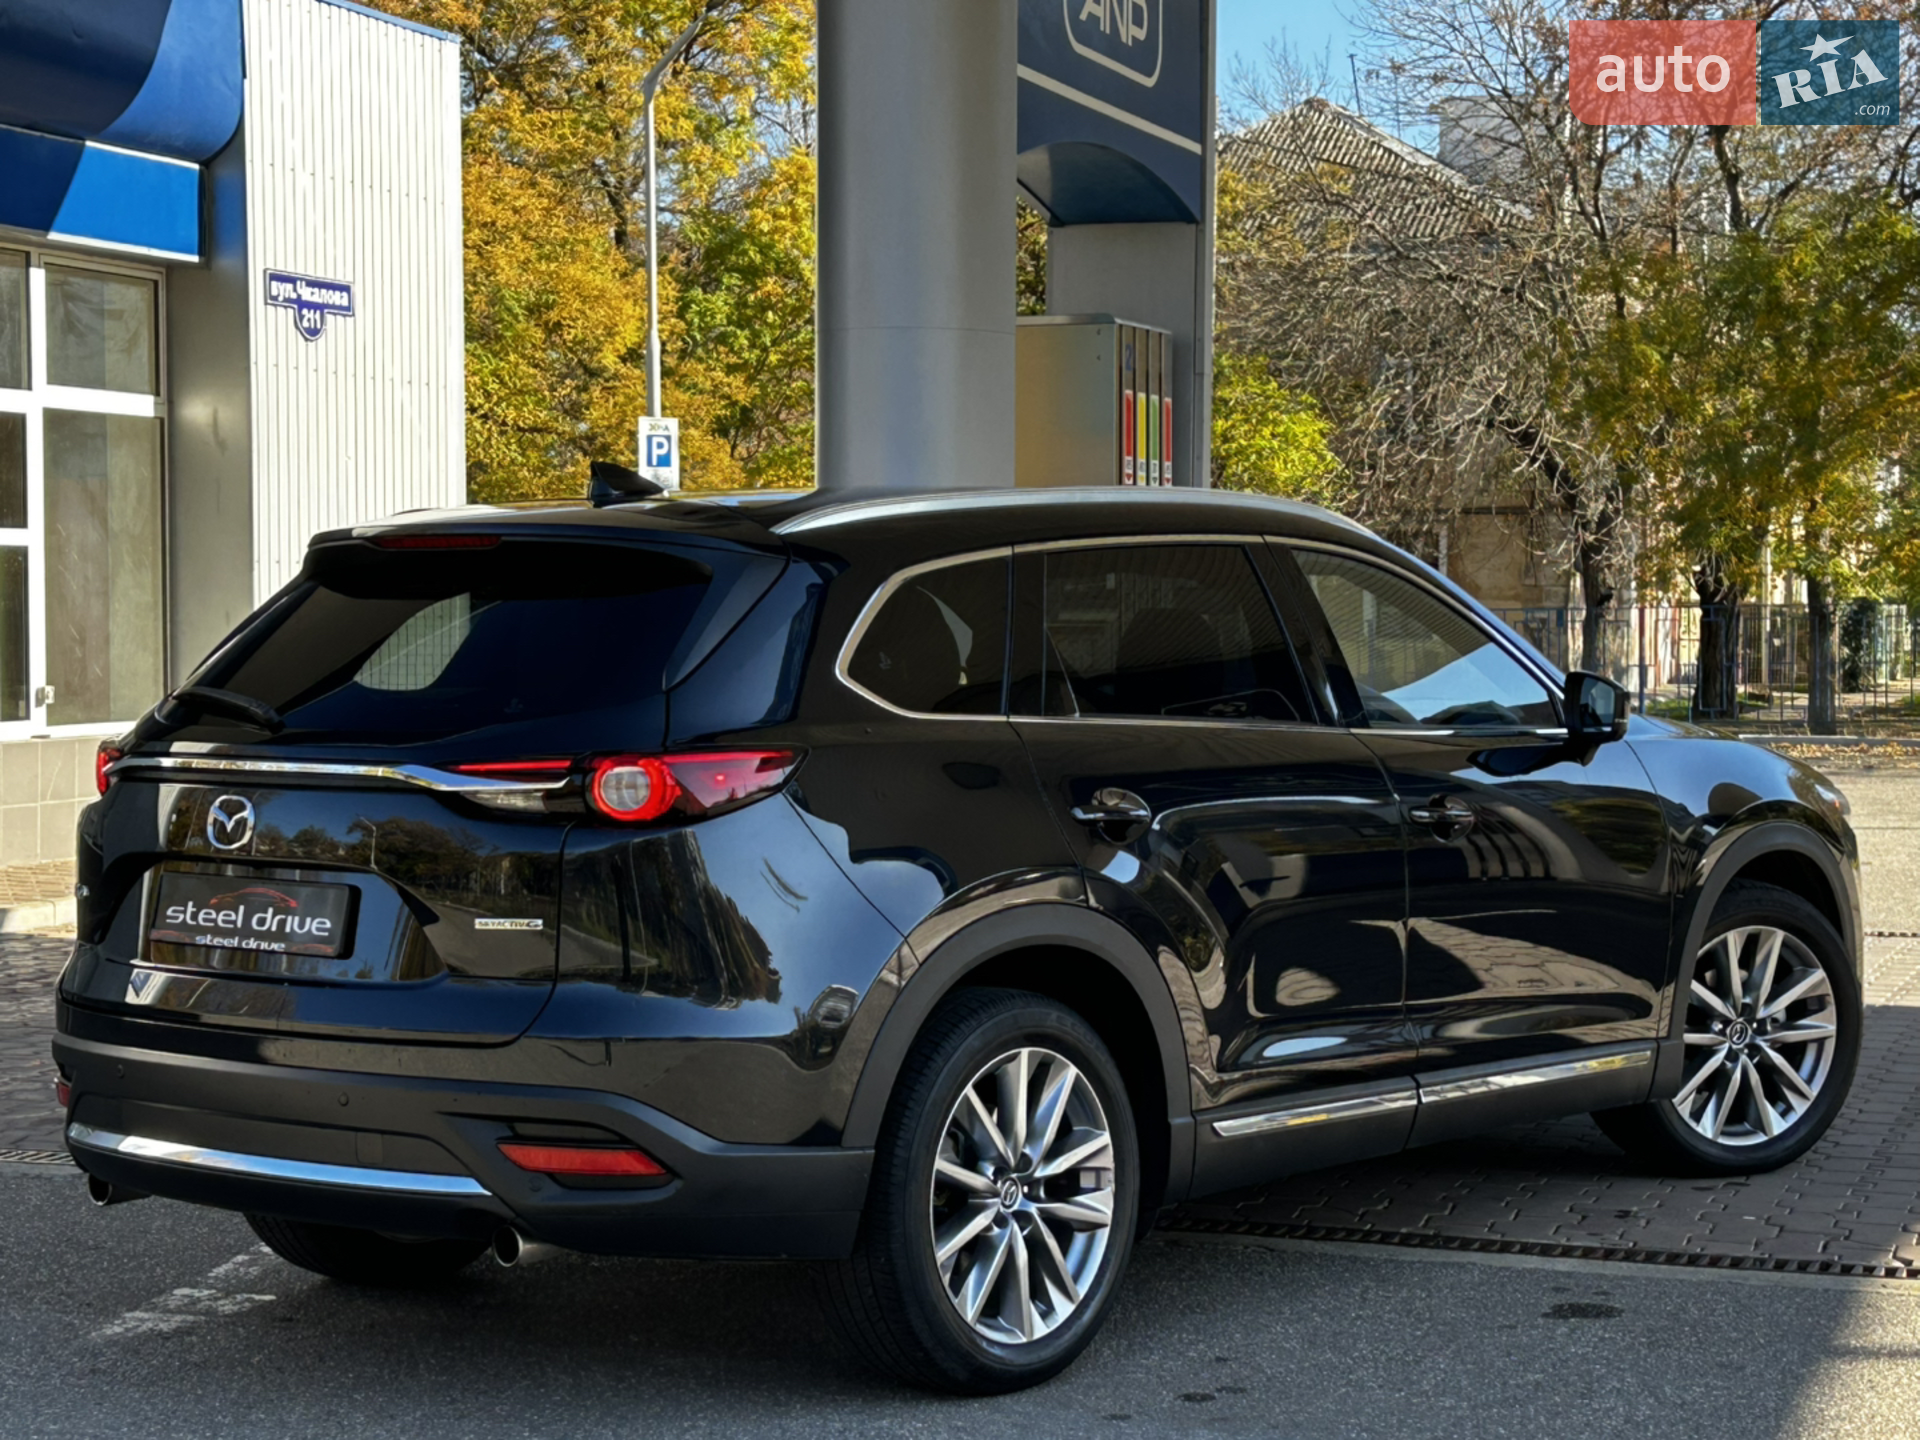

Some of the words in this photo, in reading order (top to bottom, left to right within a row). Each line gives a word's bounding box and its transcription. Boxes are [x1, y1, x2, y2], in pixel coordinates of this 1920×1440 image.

[302, 308, 321, 329] 211
[1125, 344, 1133, 371] 2
[652, 436, 669, 466] P
[166, 901, 244, 928] steel
[251, 907, 331, 936] drive
[195, 934, 239, 947] steel
[242, 937, 286, 951] drive
